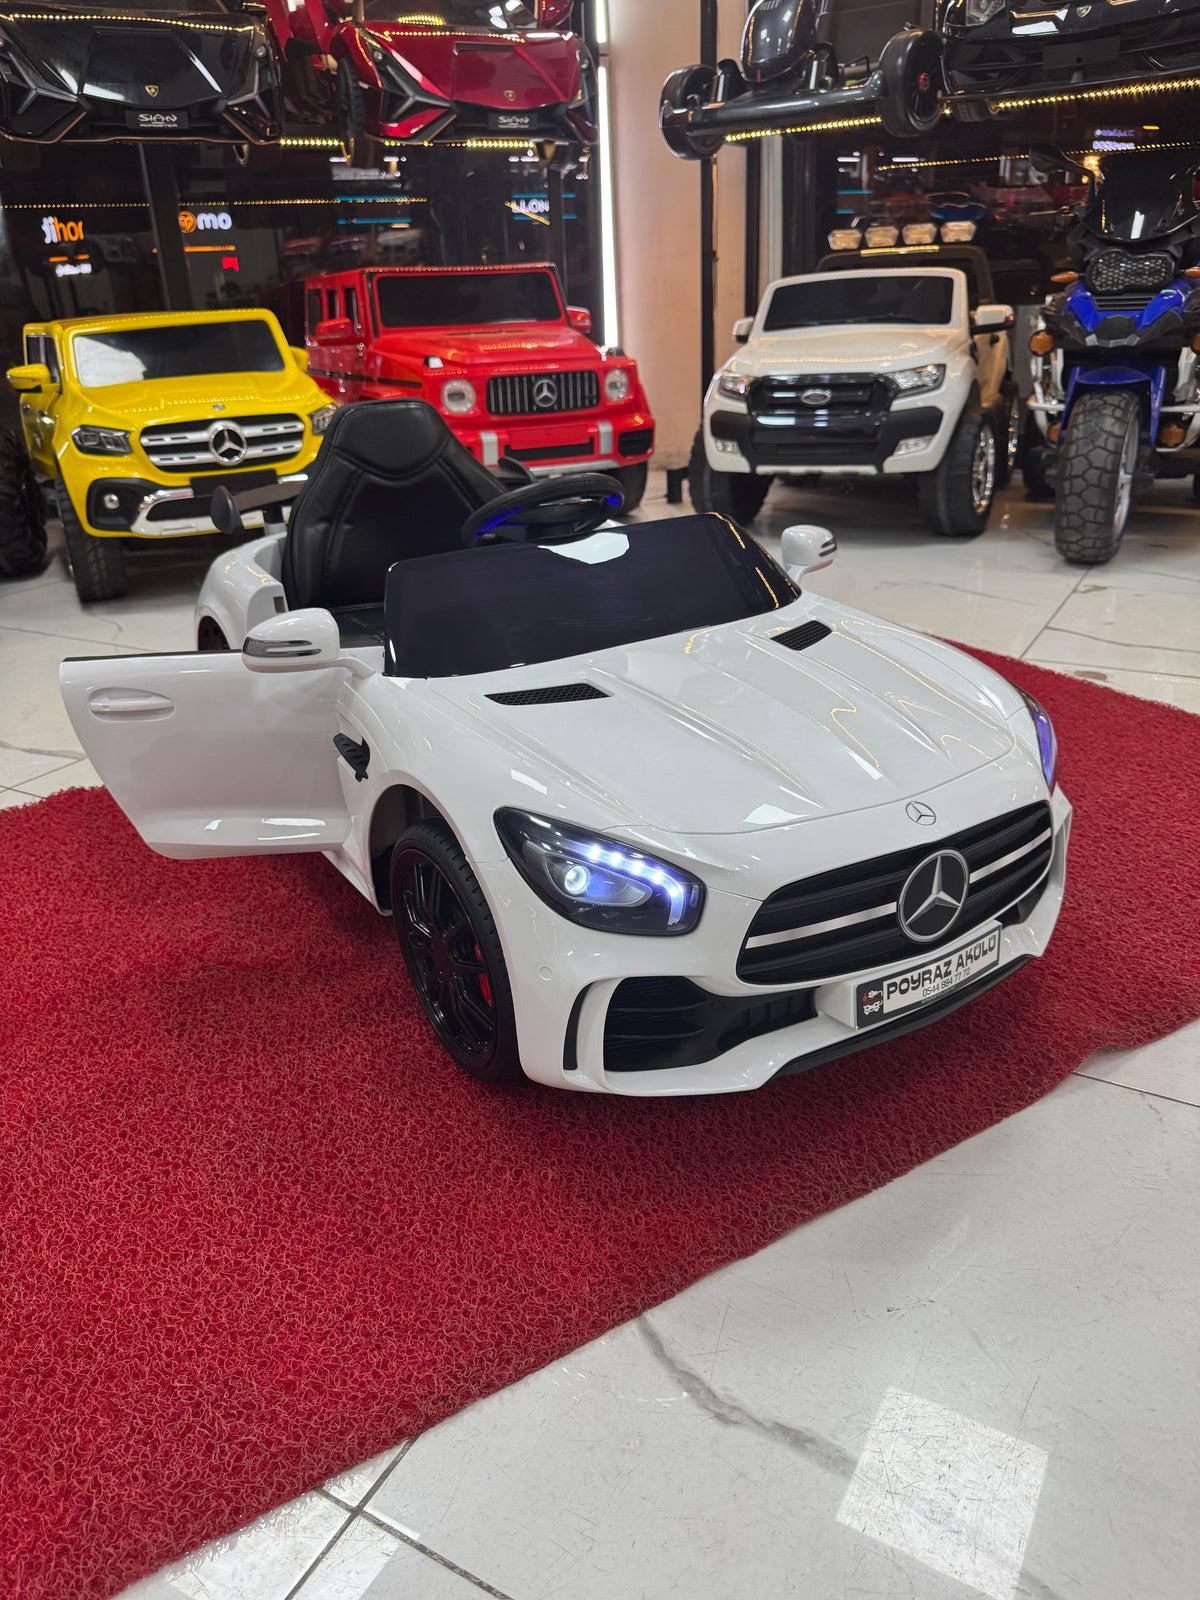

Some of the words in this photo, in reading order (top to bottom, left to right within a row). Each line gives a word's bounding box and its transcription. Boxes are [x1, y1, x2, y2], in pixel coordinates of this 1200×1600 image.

[887, 958, 952, 1000] POYRAZ
[922, 983, 940, 997] 0544
[953, 972, 962, 983] 77
